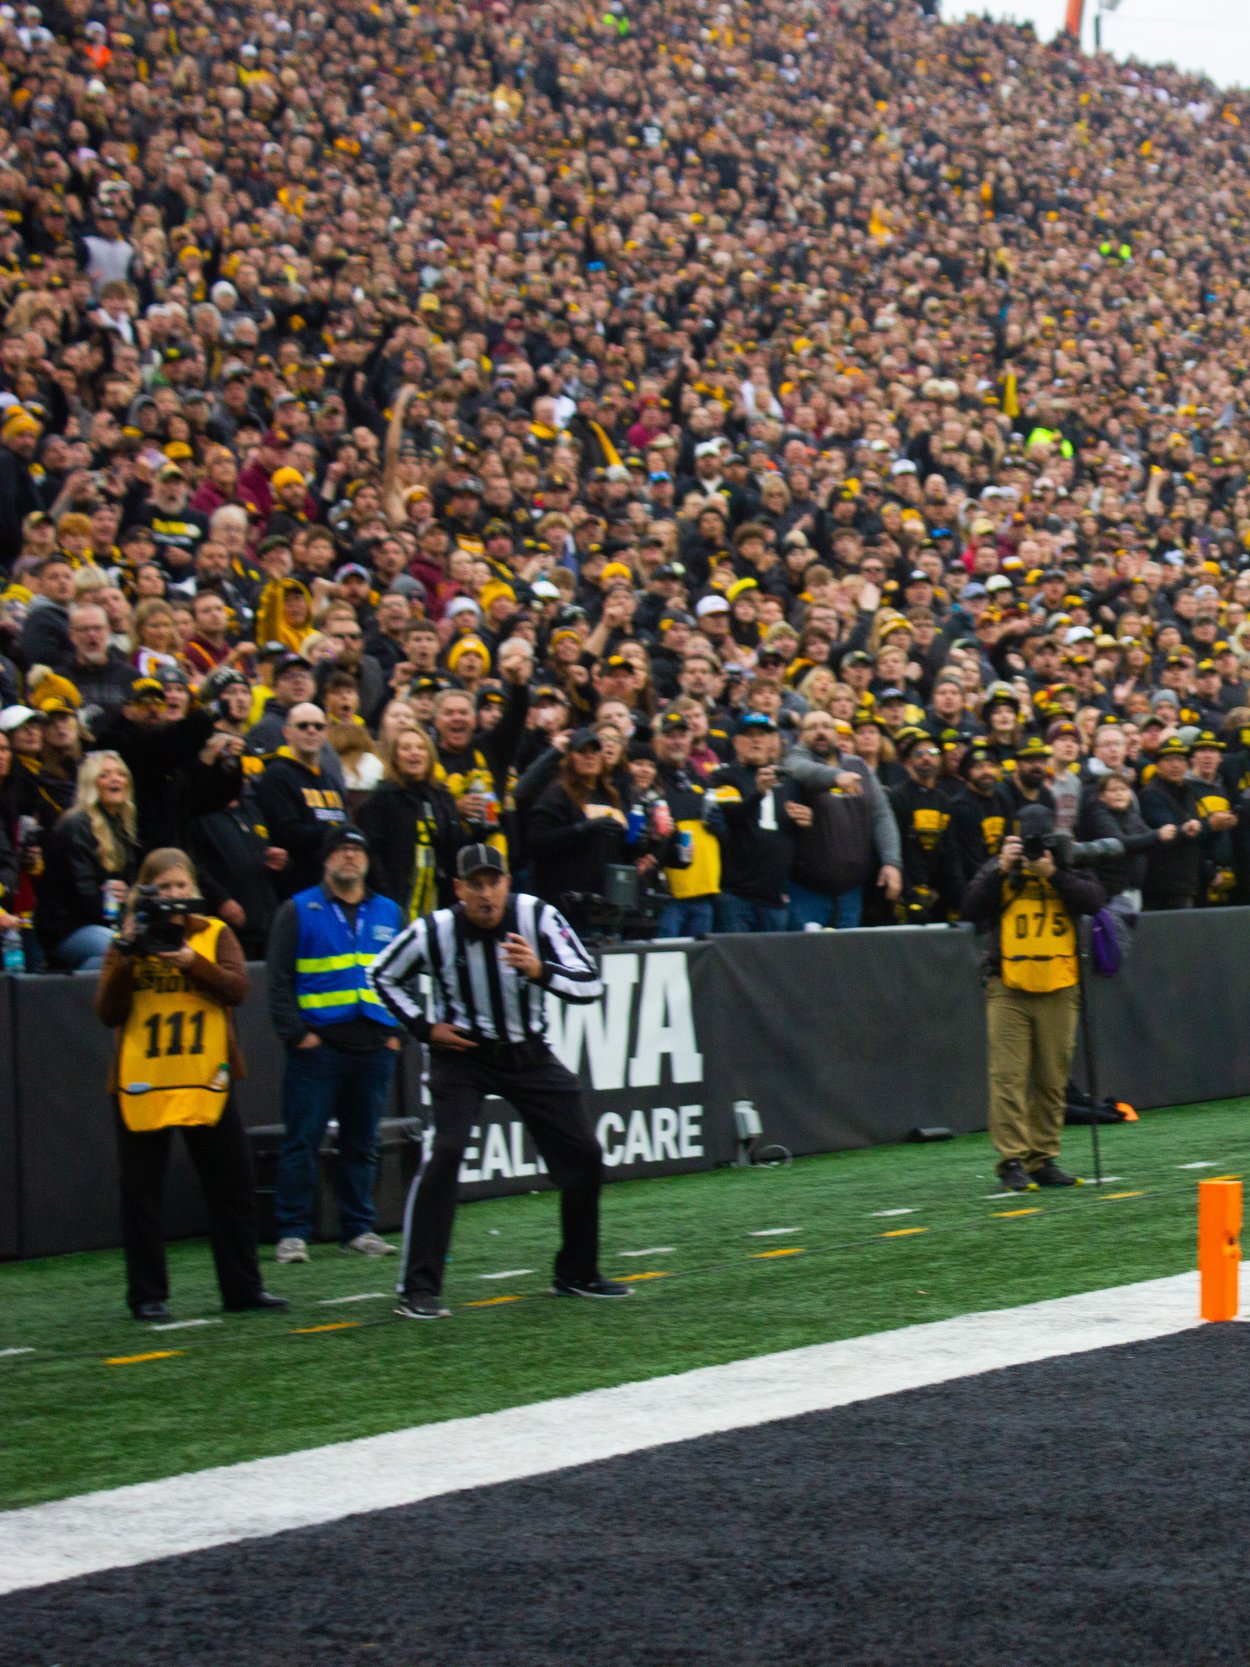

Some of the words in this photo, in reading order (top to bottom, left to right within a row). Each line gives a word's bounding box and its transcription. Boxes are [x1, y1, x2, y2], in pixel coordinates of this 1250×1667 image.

[1015, 911, 1068, 940] 075
[145, 1011, 205, 1059] 111
[596, 1104, 704, 1168] CARE
